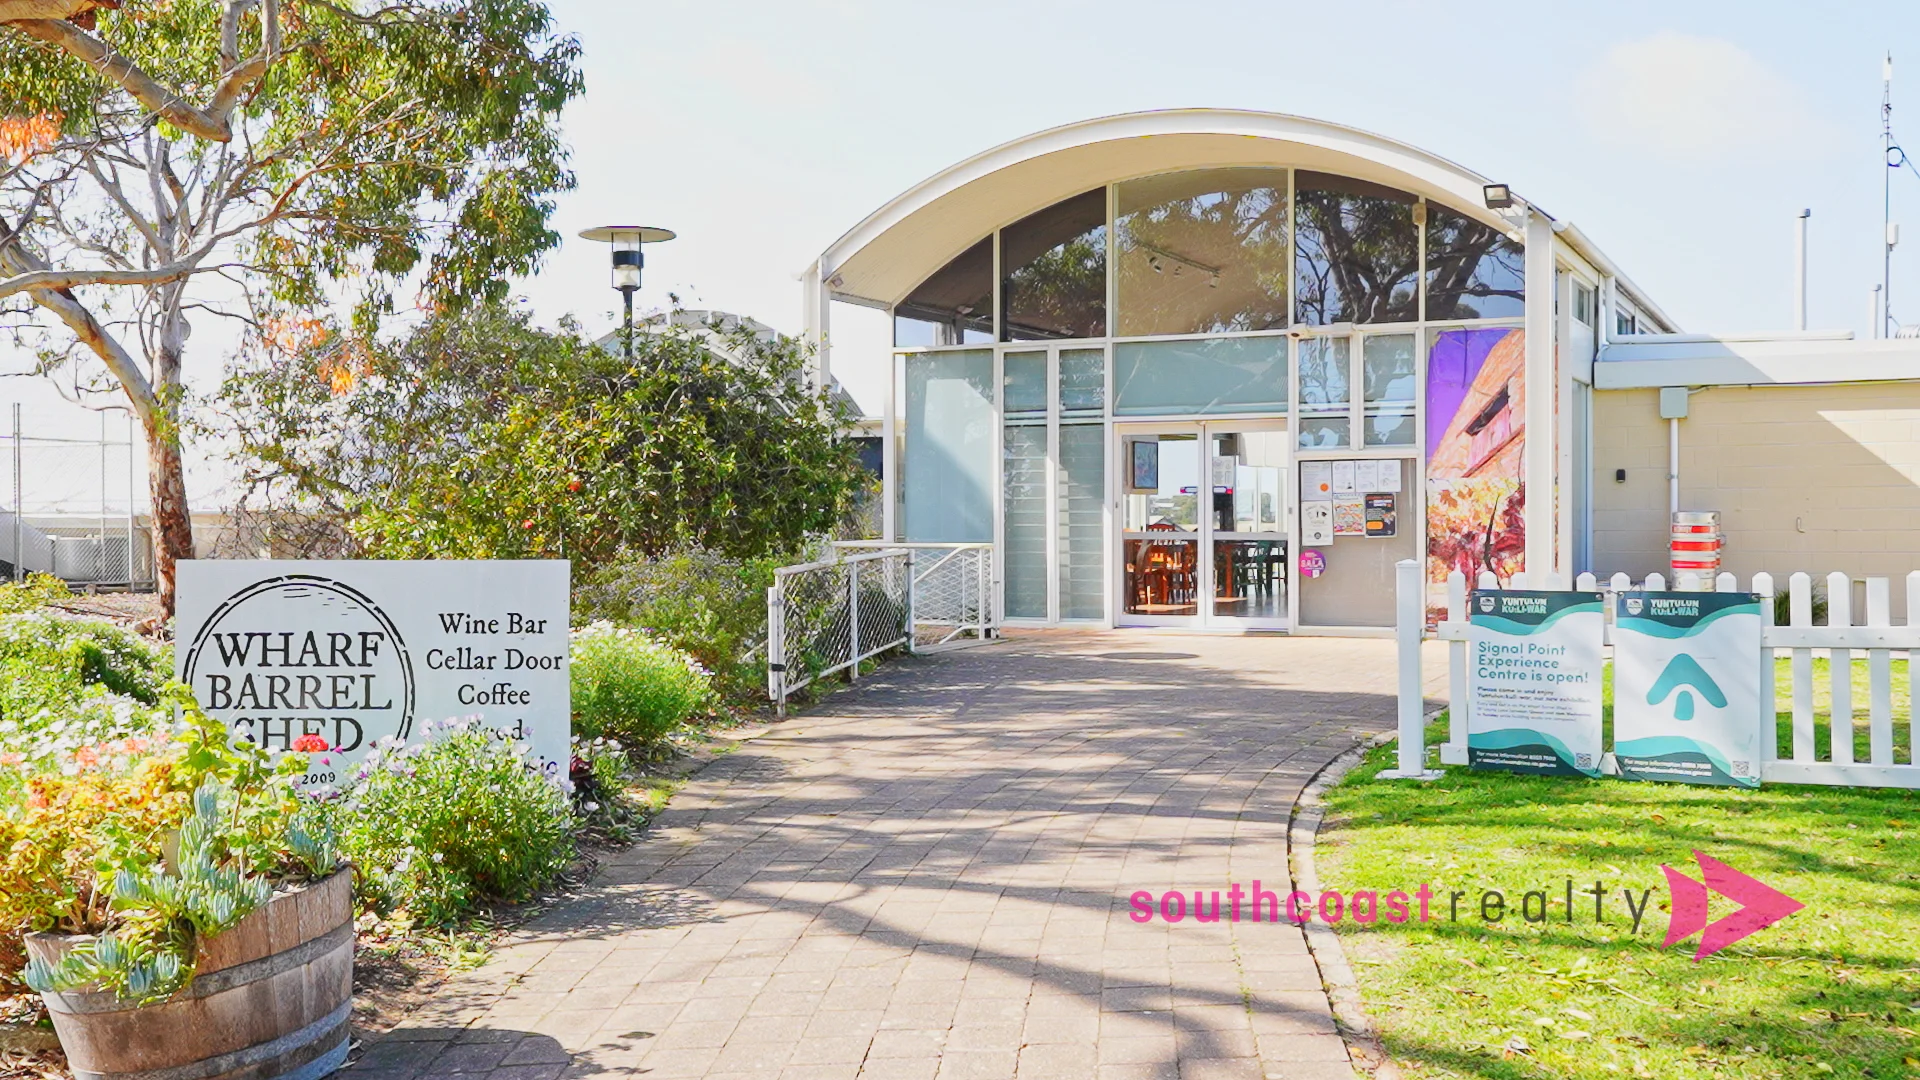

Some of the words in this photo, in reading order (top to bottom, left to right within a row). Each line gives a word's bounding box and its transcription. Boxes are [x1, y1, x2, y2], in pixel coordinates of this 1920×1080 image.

[1501, 597, 1547, 605] YUNTULUN
[1650, 599, 1699, 607] YUNTULUN
[439, 612, 499, 635] Wine
[506, 612, 548, 635] Bar
[213, 630, 385, 668] WHARF
[1478, 641, 1523, 656] Signal
[1528, 643, 1566, 655] Point
[426, 648, 497, 671] Cellar
[504, 649, 563, 671] Door
[1478, 654, 1559, 669] Experience
[1478, 667, 1527, 680] Centre
[1531, 669, 1542, 681] is
[1546, 672, 1588, 685] open!
[205, 673, 393, 711] BARREL
[458, 682, 531, 706] Coffee
[235, 717, 363, 752] SHED
[301, 772, 336, 785] 2009
